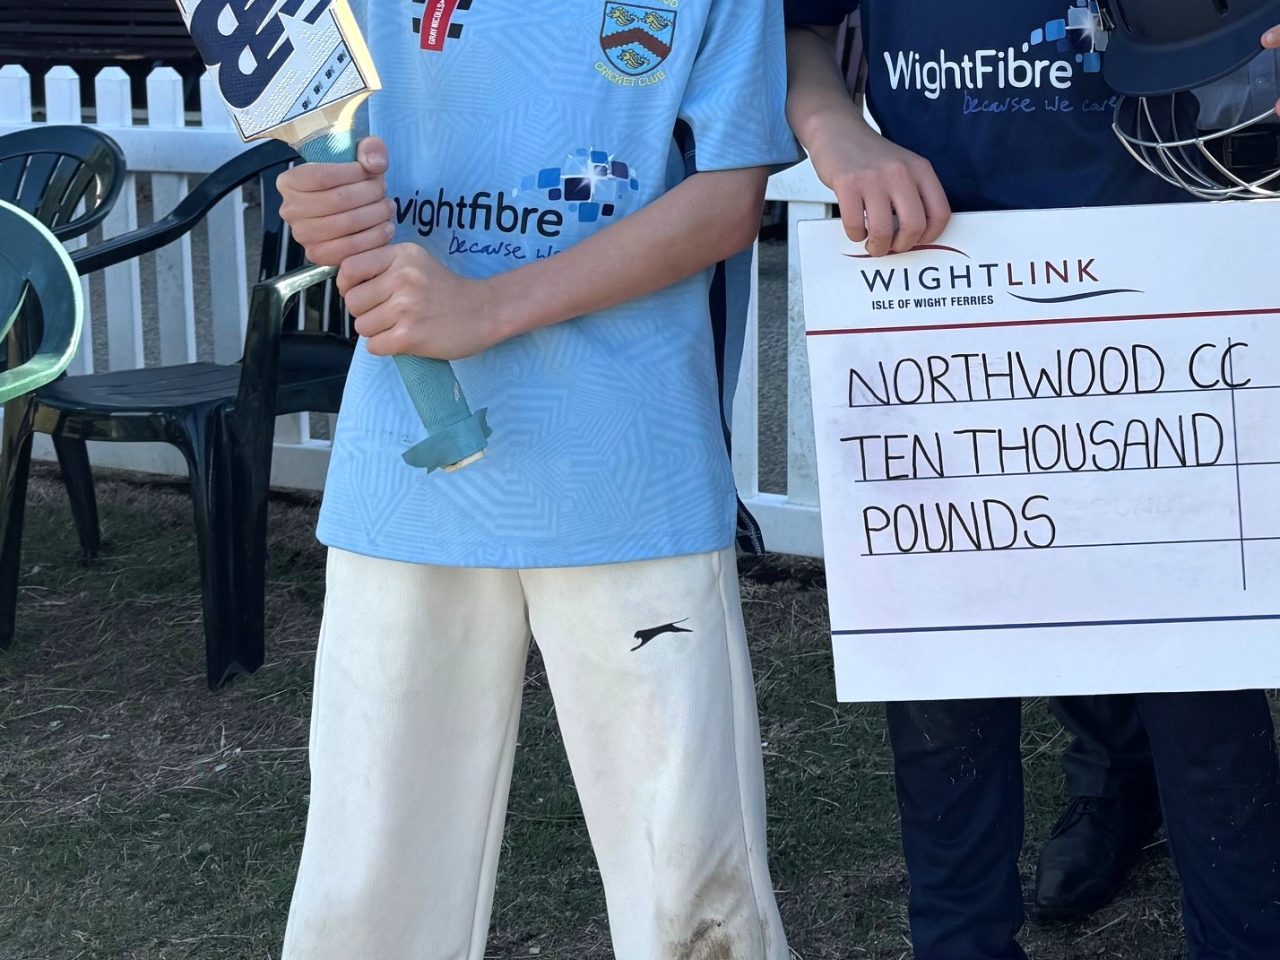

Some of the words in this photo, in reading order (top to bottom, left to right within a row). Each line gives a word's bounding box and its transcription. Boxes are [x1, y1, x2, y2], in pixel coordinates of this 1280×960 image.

[594, 61, 635, 87] CRICKET
[638, 70, 666, 87] CLUB
[883, 46, 1073, 100] WightFibre
[963, 90, 1035, 114] because
[1044, 96, 1074, 112] we
[449, 230, 526, 259] because
[860, 258, 1099, 293] WIGHTLINK
[872, 299, 894, 310] ISLE
[897, 298, 911, 309] OF
[913, 297, 947, 308] WIGHT
[950, 295, 994, 306] FERRIES
[848, 344, 1165, 407] NORTHWOOD
[1188, 342, 1252, 389] CC
[840, 432, 944, 481] TEN
[954, 413, 1224, 474] THOUSAND
[862, 495, 1056, 555] POUNDS
